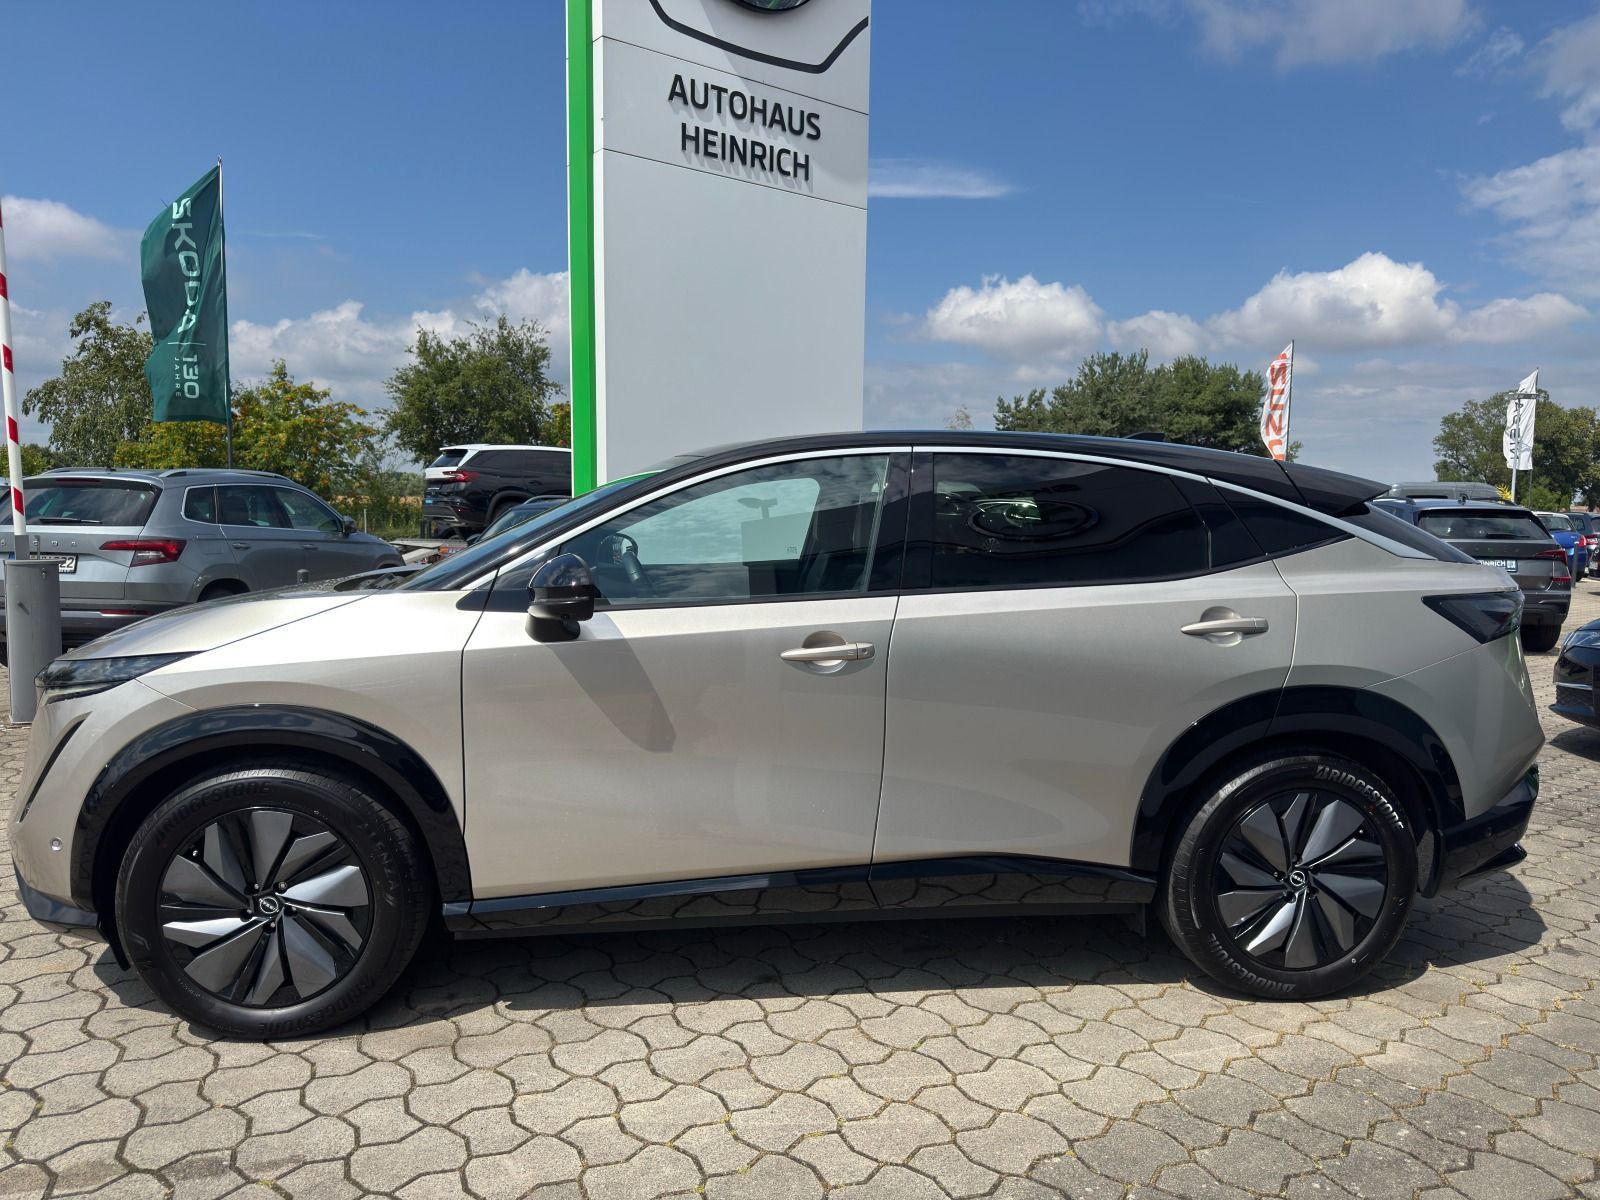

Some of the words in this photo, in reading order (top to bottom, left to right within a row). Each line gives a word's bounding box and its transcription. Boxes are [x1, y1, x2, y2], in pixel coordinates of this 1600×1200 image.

[667, 74, 821, 140] AUTOHAUS
[681, 122, 810, 181] HEINRICH
[174, 356, 182, 398] JAHRE
[182, 354, 200, 399] 130
[1315, 764, 1404, 830] BRIDGESTONE
